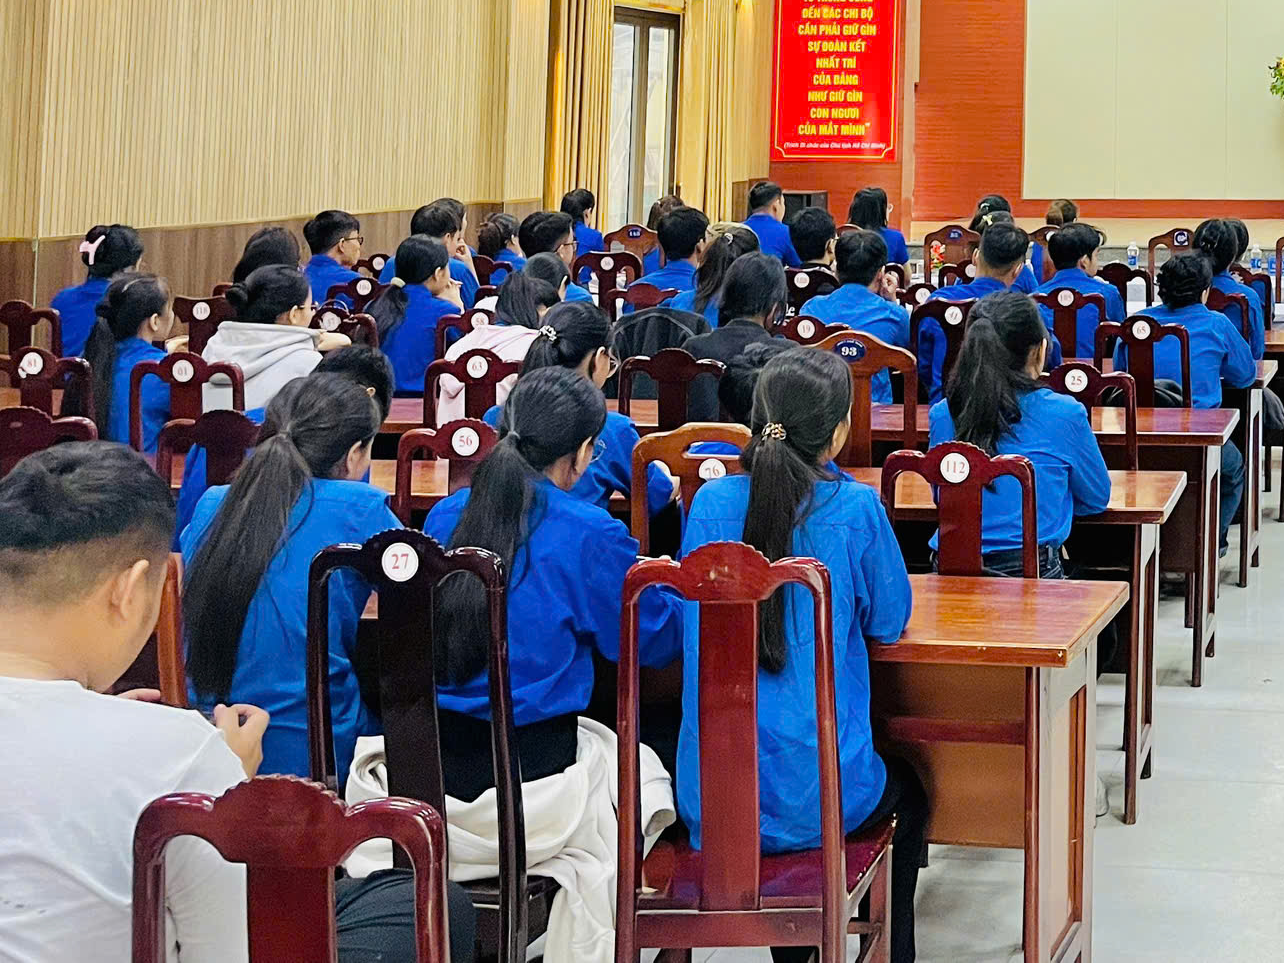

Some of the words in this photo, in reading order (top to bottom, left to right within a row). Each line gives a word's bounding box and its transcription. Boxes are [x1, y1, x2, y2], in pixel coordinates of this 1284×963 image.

[843, 8, 858, 19] CHI
[850, 39, 866, 52] KẾT
[810, 108, 829, 118] CON
[1136, 326, 1146, 334] 65
[841, 346, 857, 356] 93
[472, 361, 483, 371] 63
[1070, 376, 1082, 385] 25
[459, 435, 472, 447] 56
[705, 467, 720, 478] 76
[946, 460, 966, 474] 112
[391, 553, 410, 570] 27
